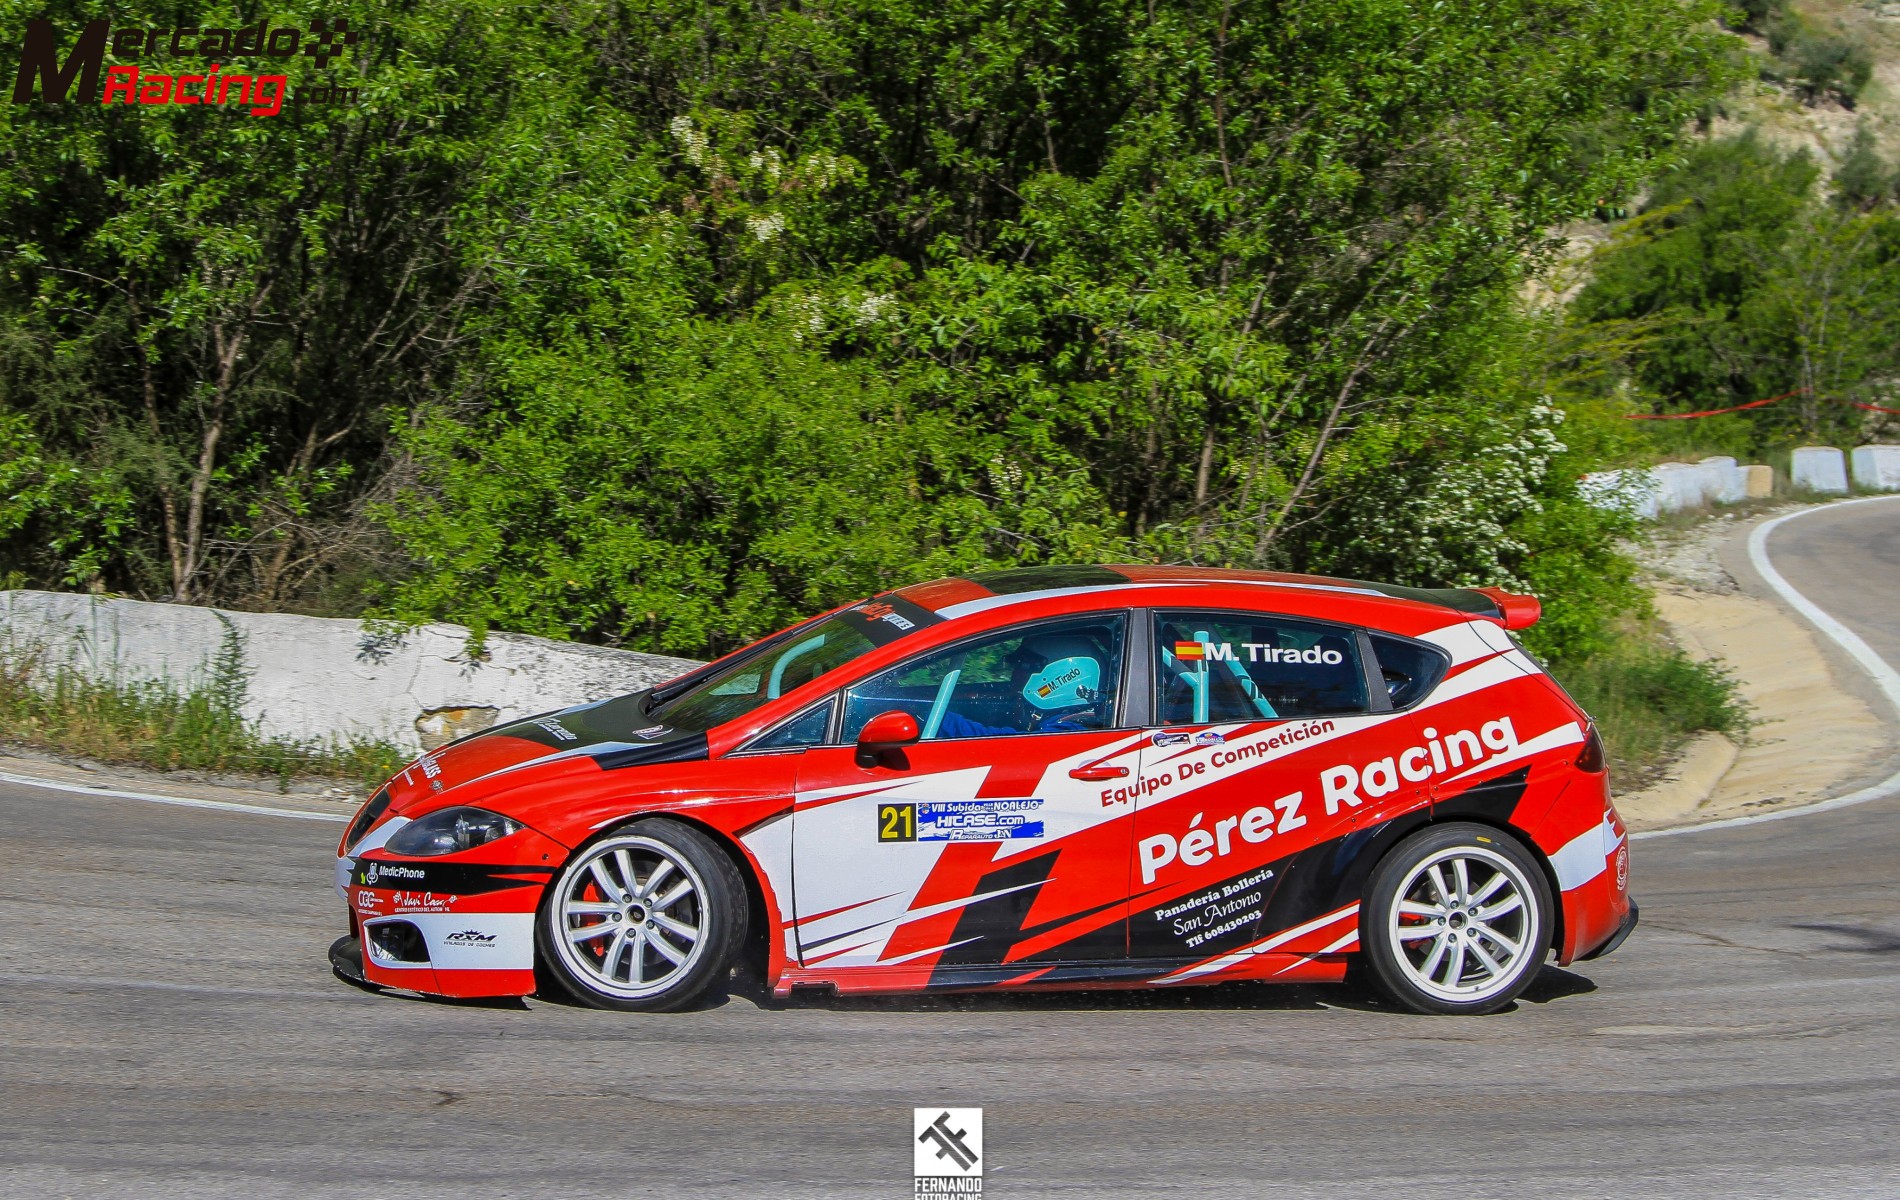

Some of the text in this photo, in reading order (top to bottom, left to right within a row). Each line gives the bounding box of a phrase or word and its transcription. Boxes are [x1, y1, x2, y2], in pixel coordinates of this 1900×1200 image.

[1205, 642, 1343, 665] M. Tirado
[1055, 668, 1080, 685] Tirado
[1101, 720, 1335, 807] Equipo De Competición
[932, 803, 946, 813] VIII
[947, 802, 981, 812] Subida
[994, 801, 1039, 810] NOALEJO
[1139, 716, 1519, 885] Pérez Racing
[881, 806, 911, 838] 21
[379, 865, 425, 879] MedicPhone
[1173, 891, 1262, 936] San Antonio
[1185, 909, 1262, 948] Tlf 608430203
